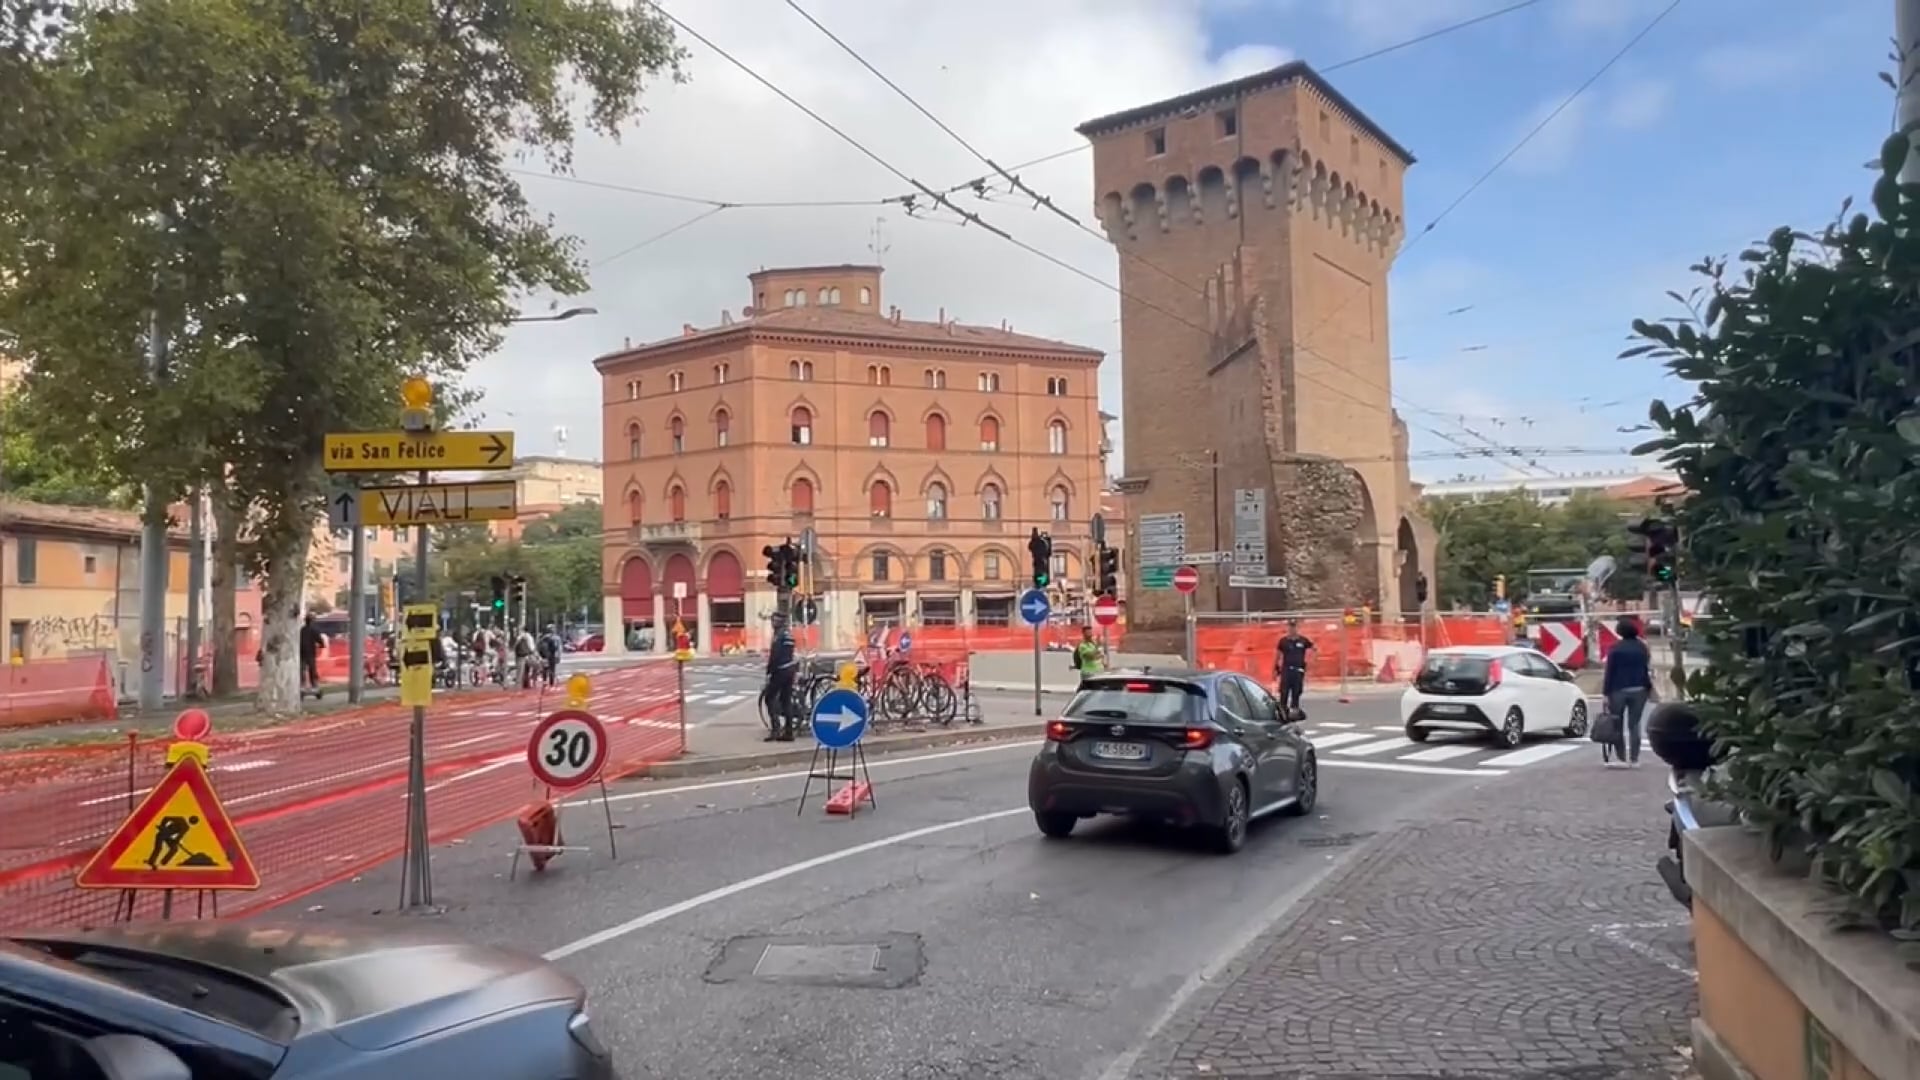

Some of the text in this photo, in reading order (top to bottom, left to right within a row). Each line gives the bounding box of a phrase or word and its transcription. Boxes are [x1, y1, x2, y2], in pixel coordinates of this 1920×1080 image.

[331, 441, 445, 460] via San Felice
[380, 485, 469, 521] VIALI
[545, 728, 591, 769] 30
